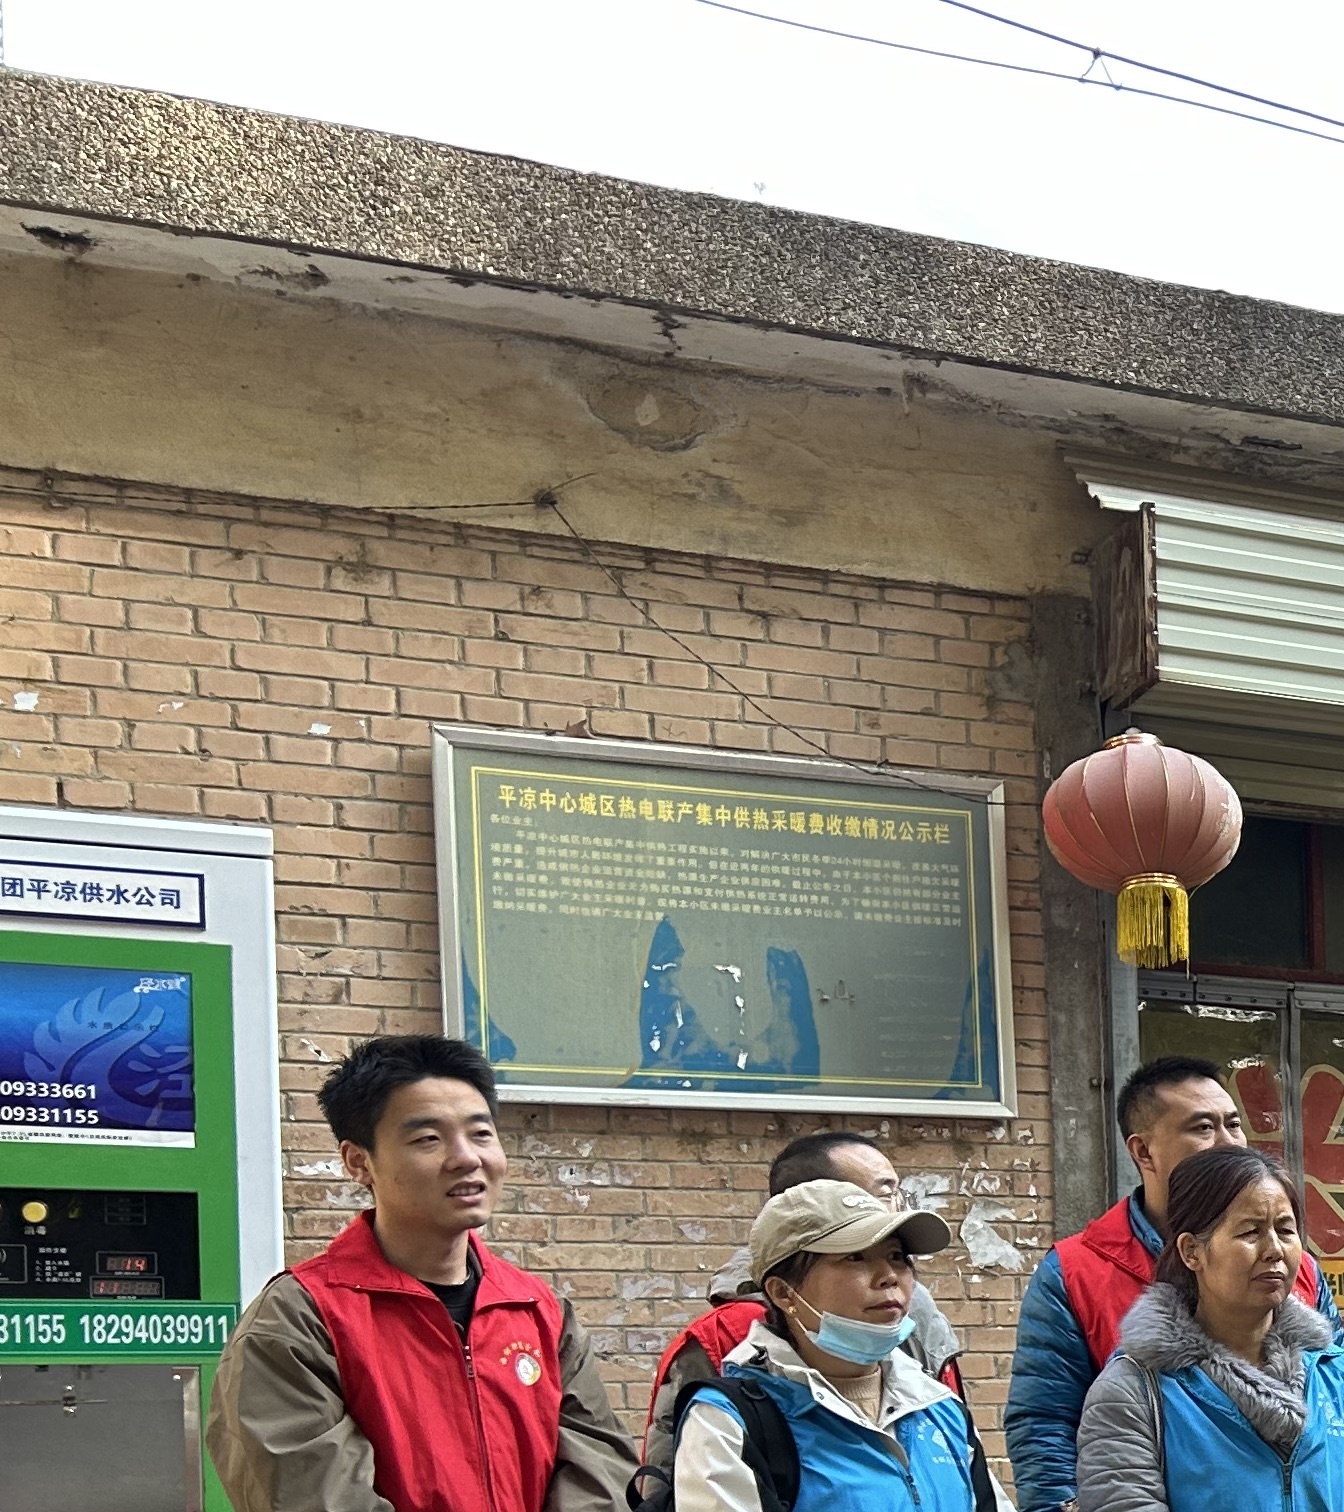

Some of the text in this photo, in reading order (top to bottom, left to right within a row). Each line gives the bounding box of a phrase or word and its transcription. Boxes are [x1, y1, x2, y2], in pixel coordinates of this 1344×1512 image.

[498, 784, 951, 845] 平凉中心城区热电联产集中供热采暖费收缴情况公示栏
[1, 876, 181, 909] 团平凉供水公司
[1, 1081, 97, 1100] 09333661
[1, 1106, 99, 1125] 09331155
[79, 1314, 228, 1344] 18294039911
